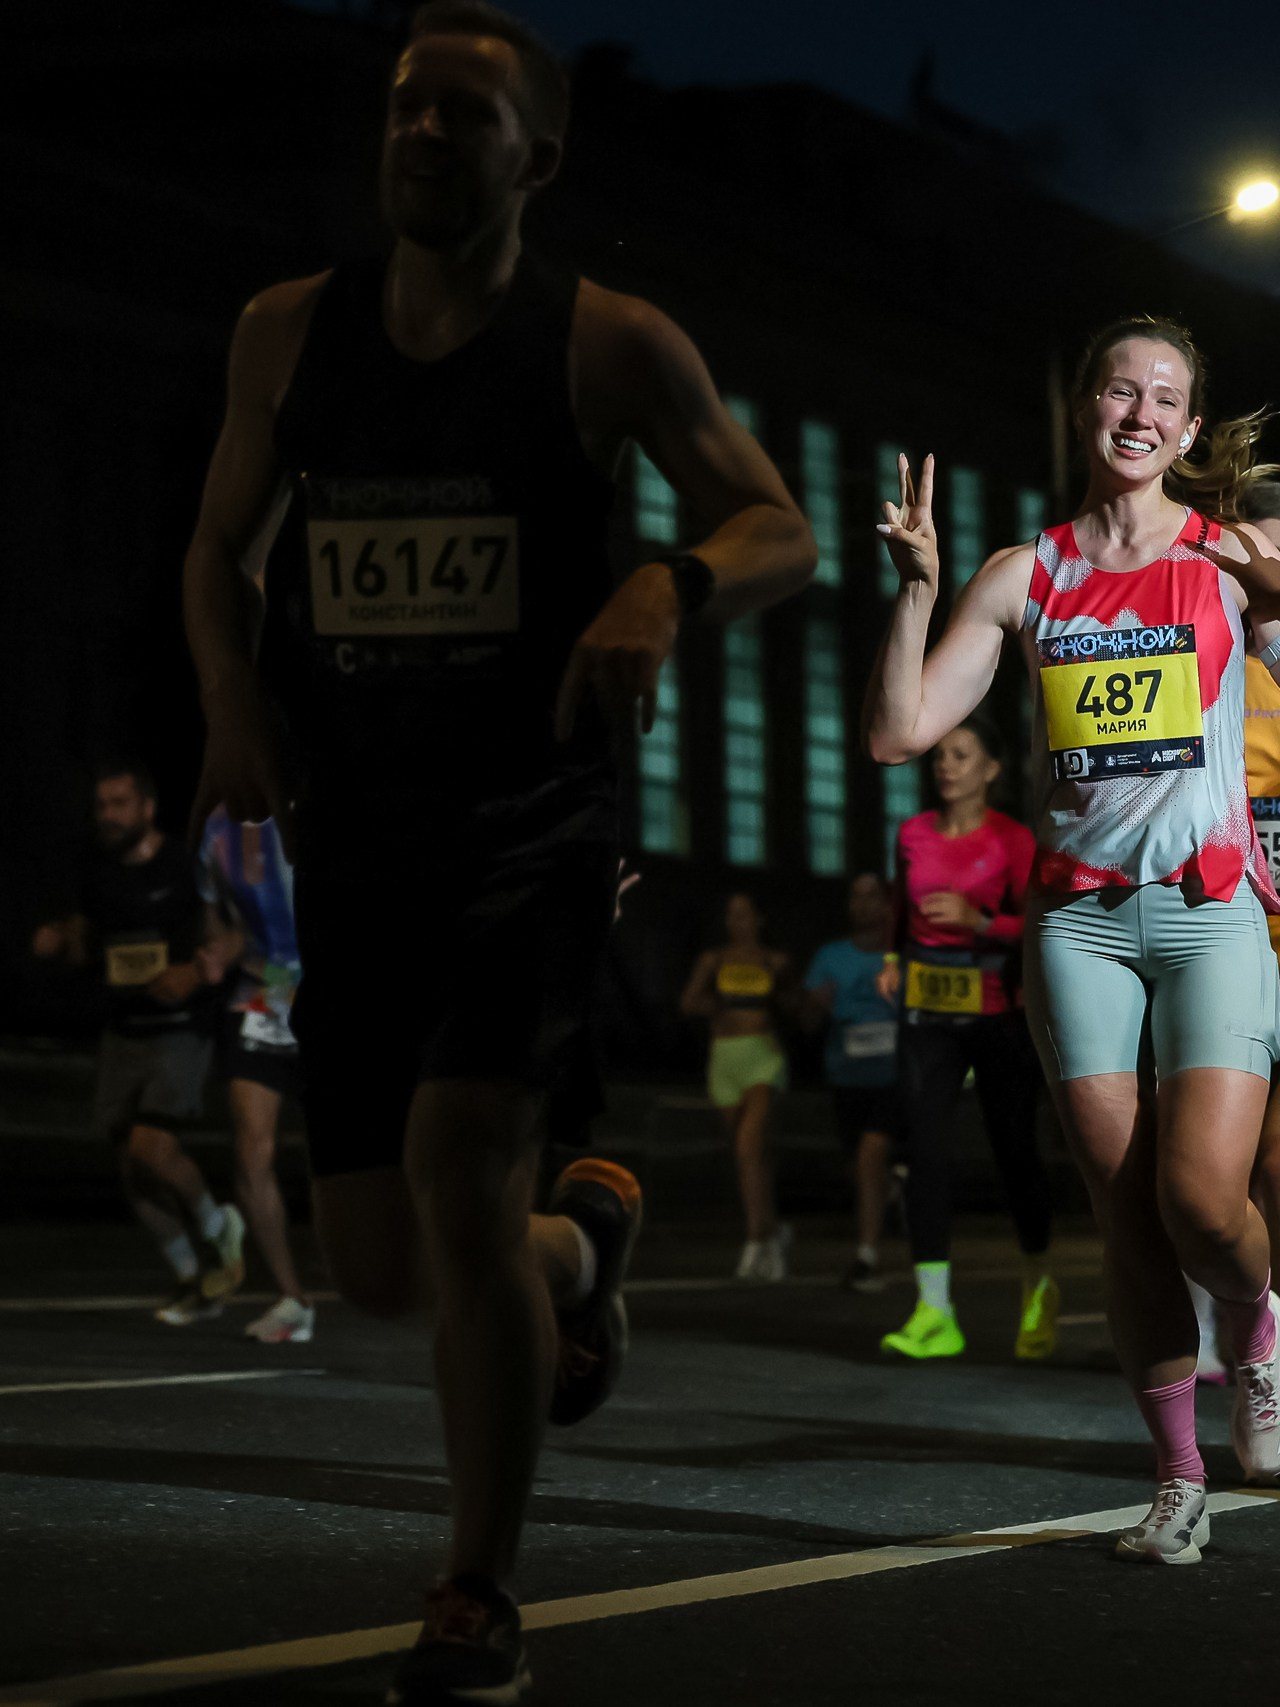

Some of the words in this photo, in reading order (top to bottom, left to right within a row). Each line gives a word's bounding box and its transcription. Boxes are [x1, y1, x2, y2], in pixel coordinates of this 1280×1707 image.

[319, 536, 509, 598] 16147
[348, 603, 478, 621] КОНСТАНТИН
[1057, 625, 1177, 658] НОЧНОЙ
[1075, 669, 1163, 718] 487
[1096, 719, 1148, 735] МАРИЯ
